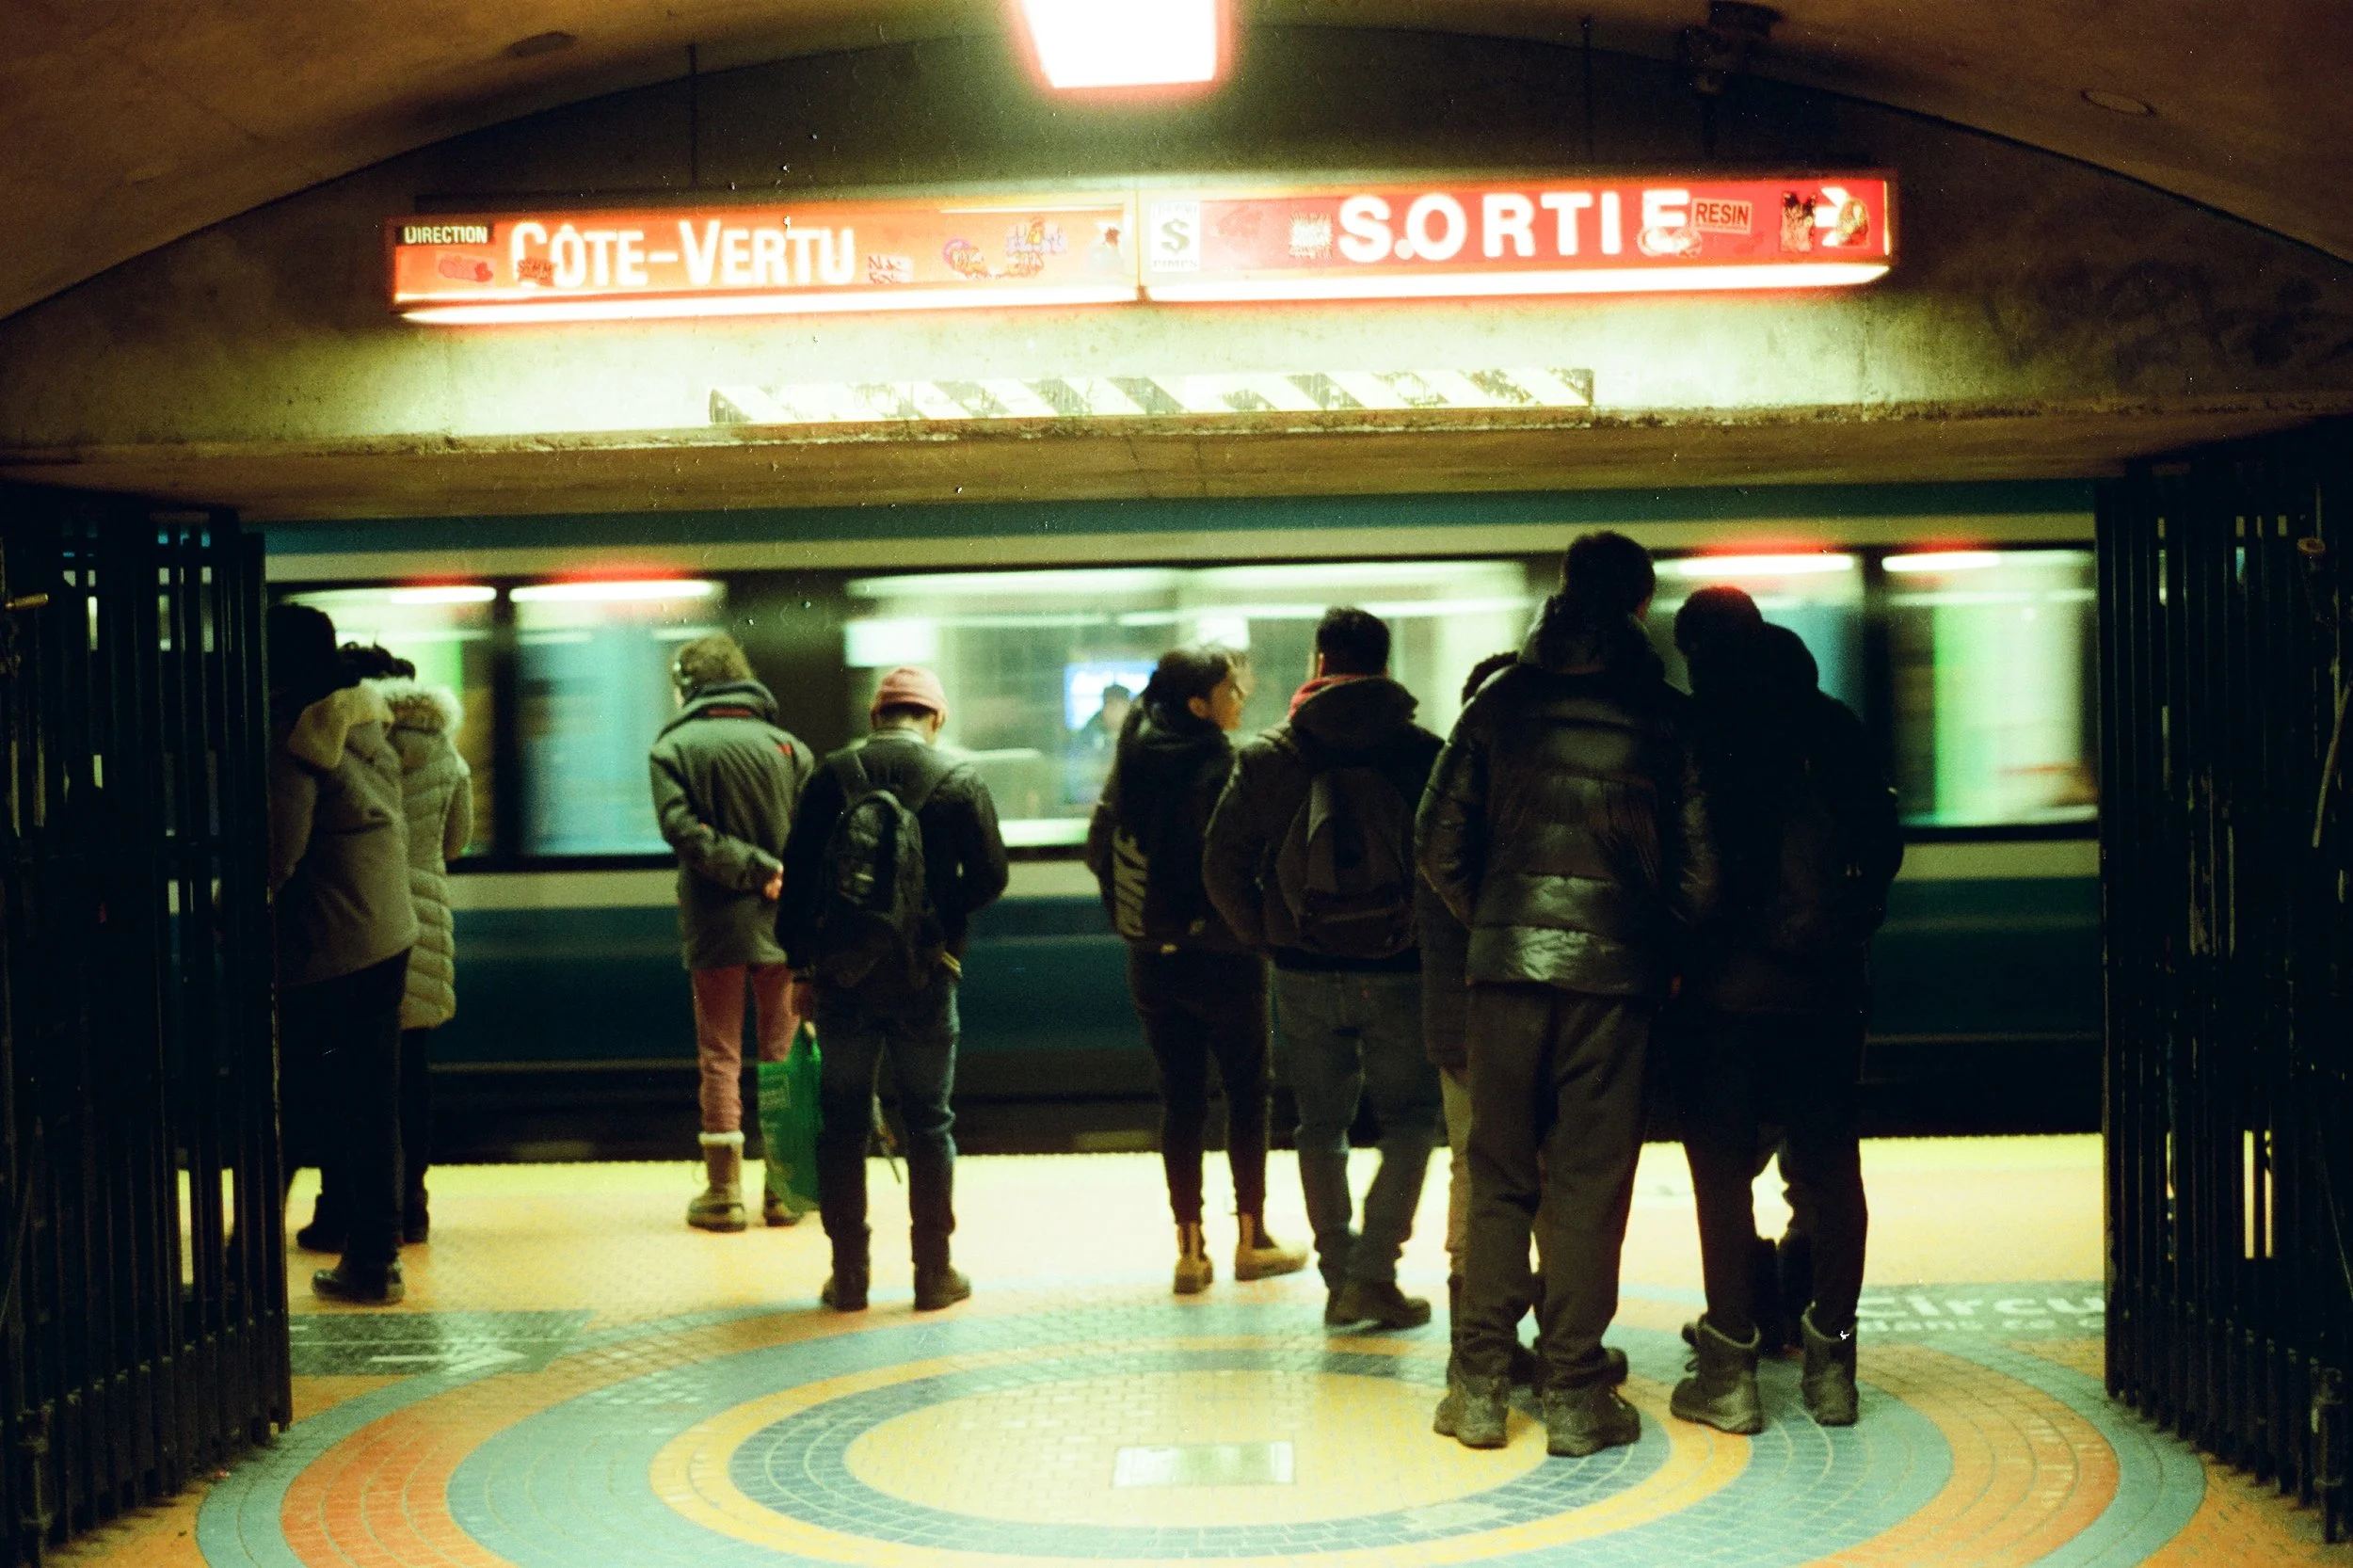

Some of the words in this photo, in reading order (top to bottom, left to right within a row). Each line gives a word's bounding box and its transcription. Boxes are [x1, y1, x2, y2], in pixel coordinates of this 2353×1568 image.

[1338, 189, 1690, 262] SORTIE
[1695, 202, 1750, 226] RESIN
[404, 226, 488, 245] DIRECTION
